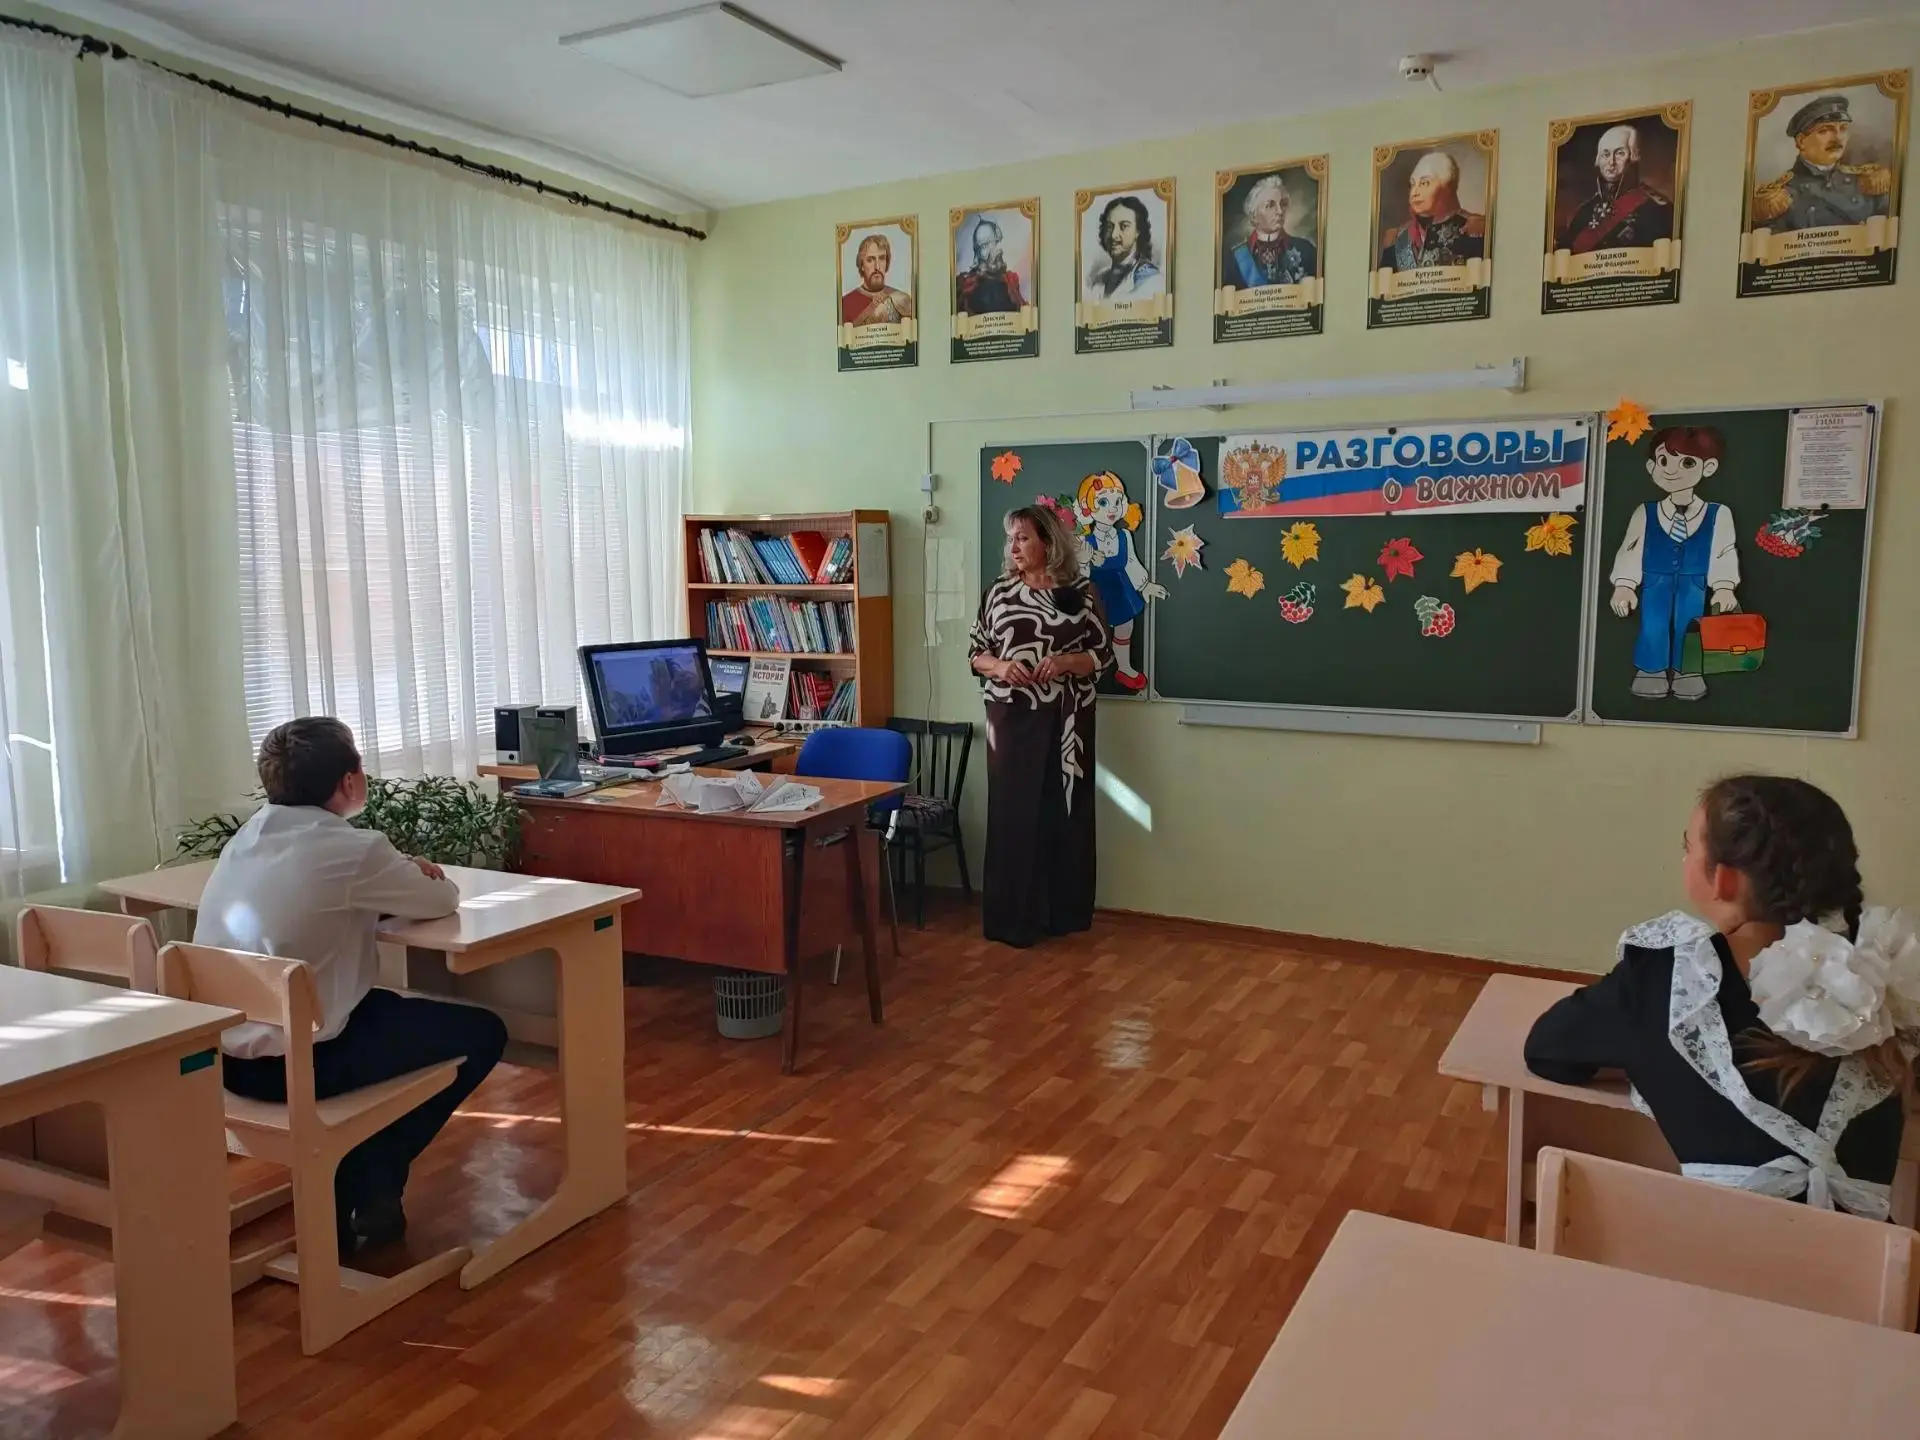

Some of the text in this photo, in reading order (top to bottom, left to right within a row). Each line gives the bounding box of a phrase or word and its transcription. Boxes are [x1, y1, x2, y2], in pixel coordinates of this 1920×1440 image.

[1797, 230, 1840, 240] Нахимов
[1595, 251, 1628, 260] Ушаков
[1415, 270, 1444, 278] Кутузов
[1295, 429, 1564, 470] РАЗГОВОРЫ
[1383, 472, 1561, 504] о важном
[752, 671, 785, 681] ИСТОРИЯ
